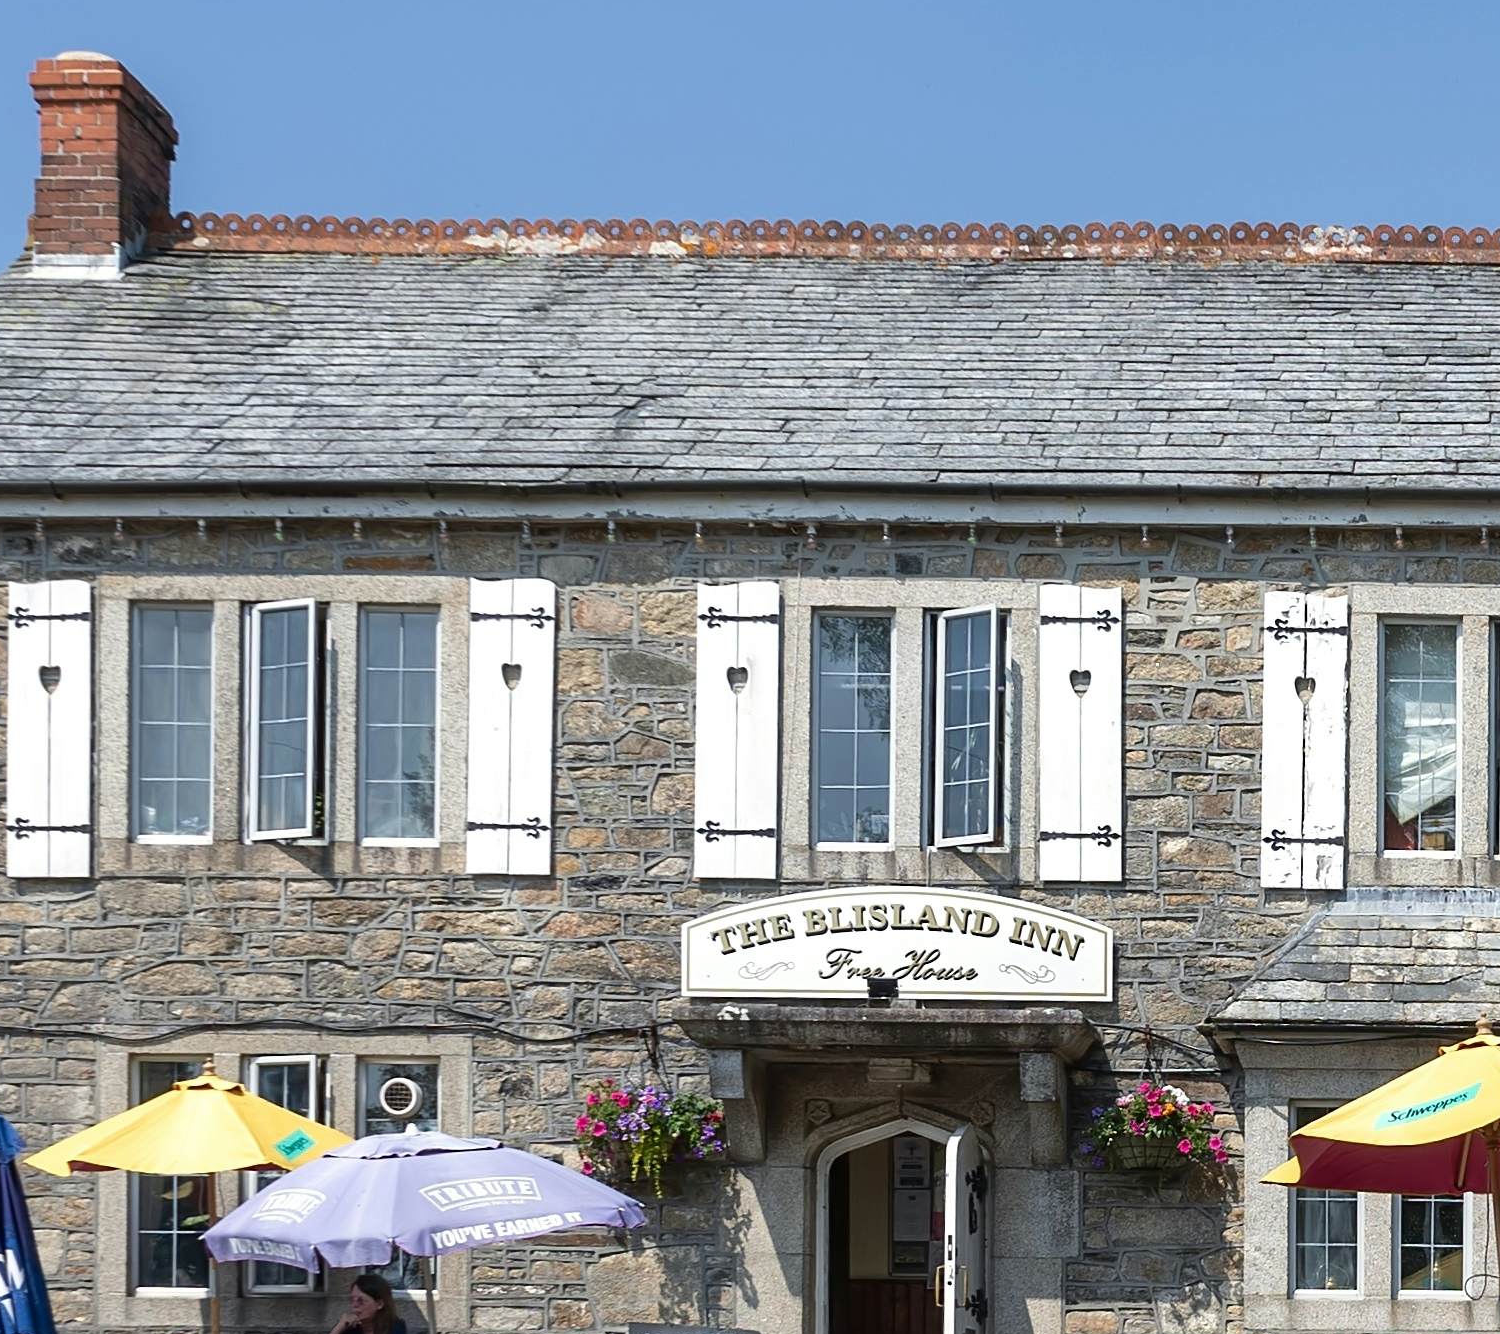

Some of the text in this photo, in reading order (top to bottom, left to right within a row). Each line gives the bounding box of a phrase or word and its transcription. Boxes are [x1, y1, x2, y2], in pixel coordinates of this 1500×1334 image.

[710, 903, 1086, 961] THE BLISLAND INN
[818, 947, 979, 981] Free House
[1388, 1091, 1469, 1123] Schweppes
[427, 1180, 535, 1205] TRIBUTE
[430, 1223, 495, 1249] YOU'VE
[494, 1214, 564, 1237] EARNED
